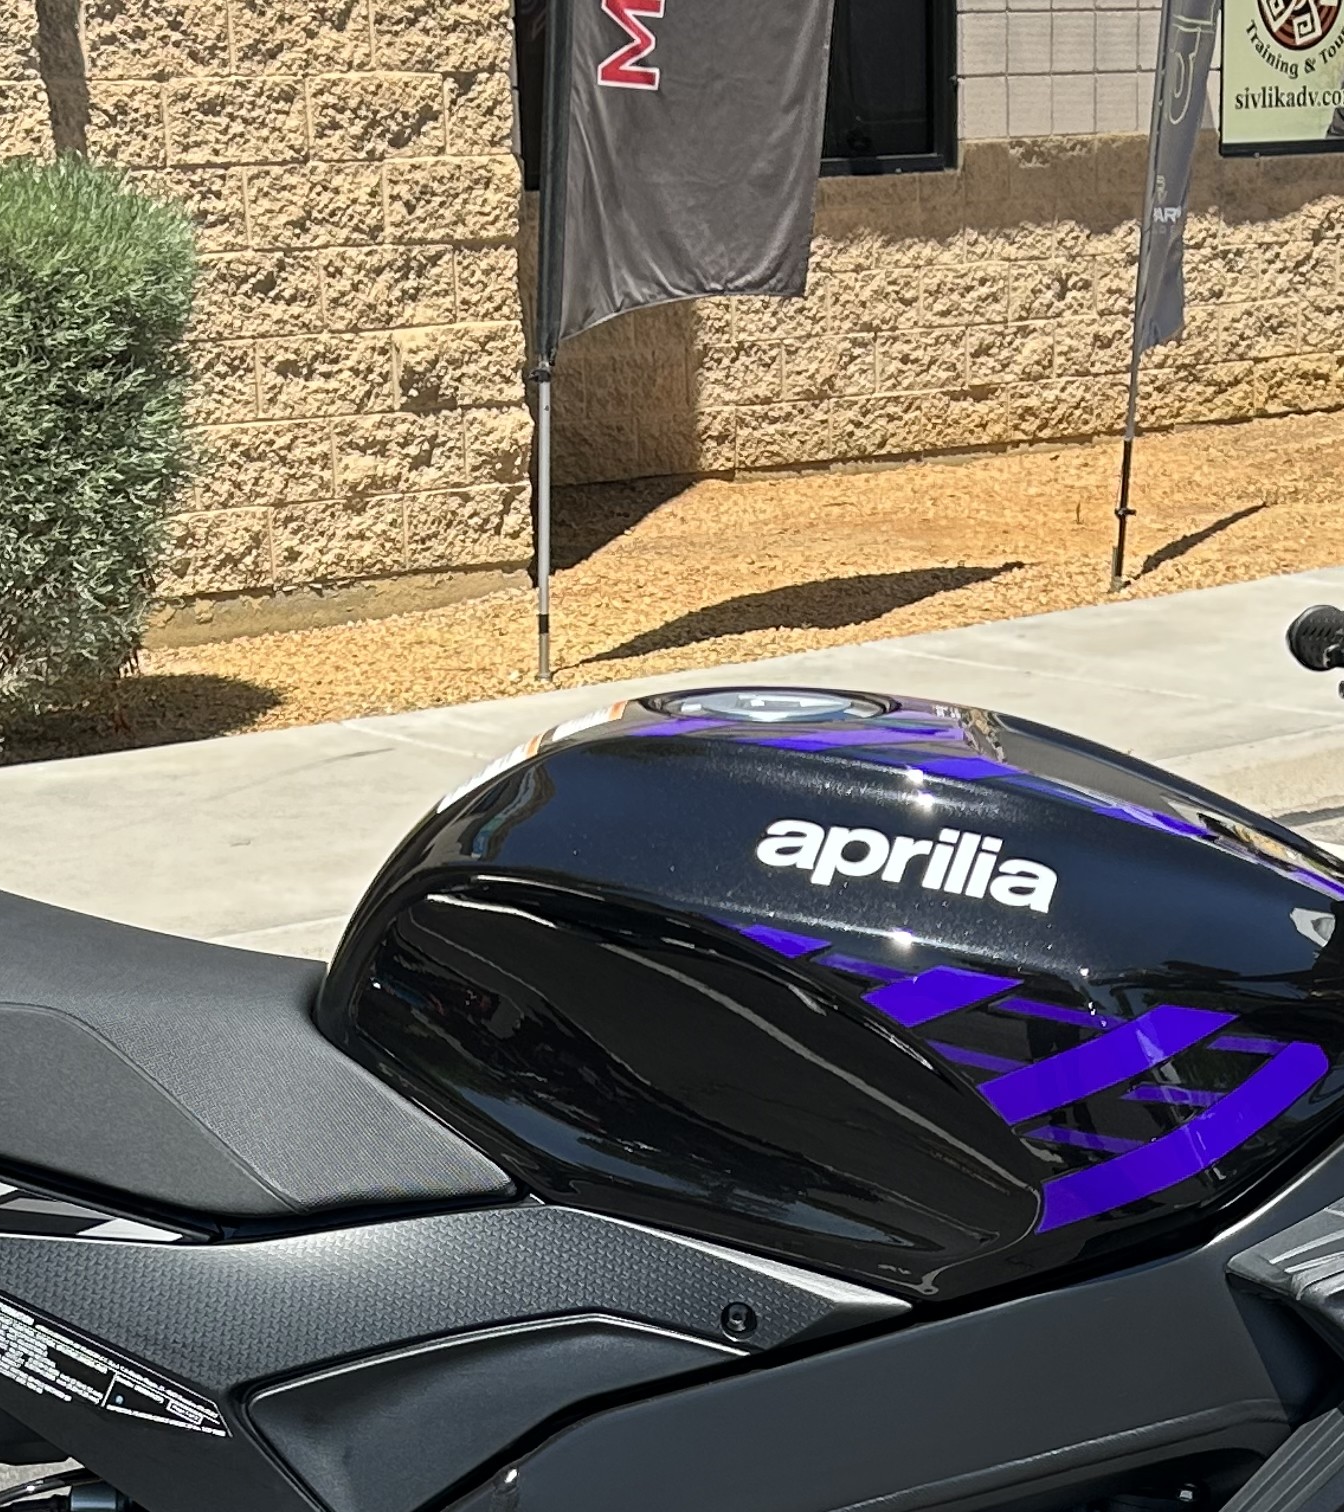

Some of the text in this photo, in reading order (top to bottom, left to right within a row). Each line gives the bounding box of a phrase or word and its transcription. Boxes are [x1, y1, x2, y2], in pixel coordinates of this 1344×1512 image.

[1245, 19, 1299, 80] Training
[1304, 58, 1316, 74] &
[756, 818, 1059, 915] aprilia
